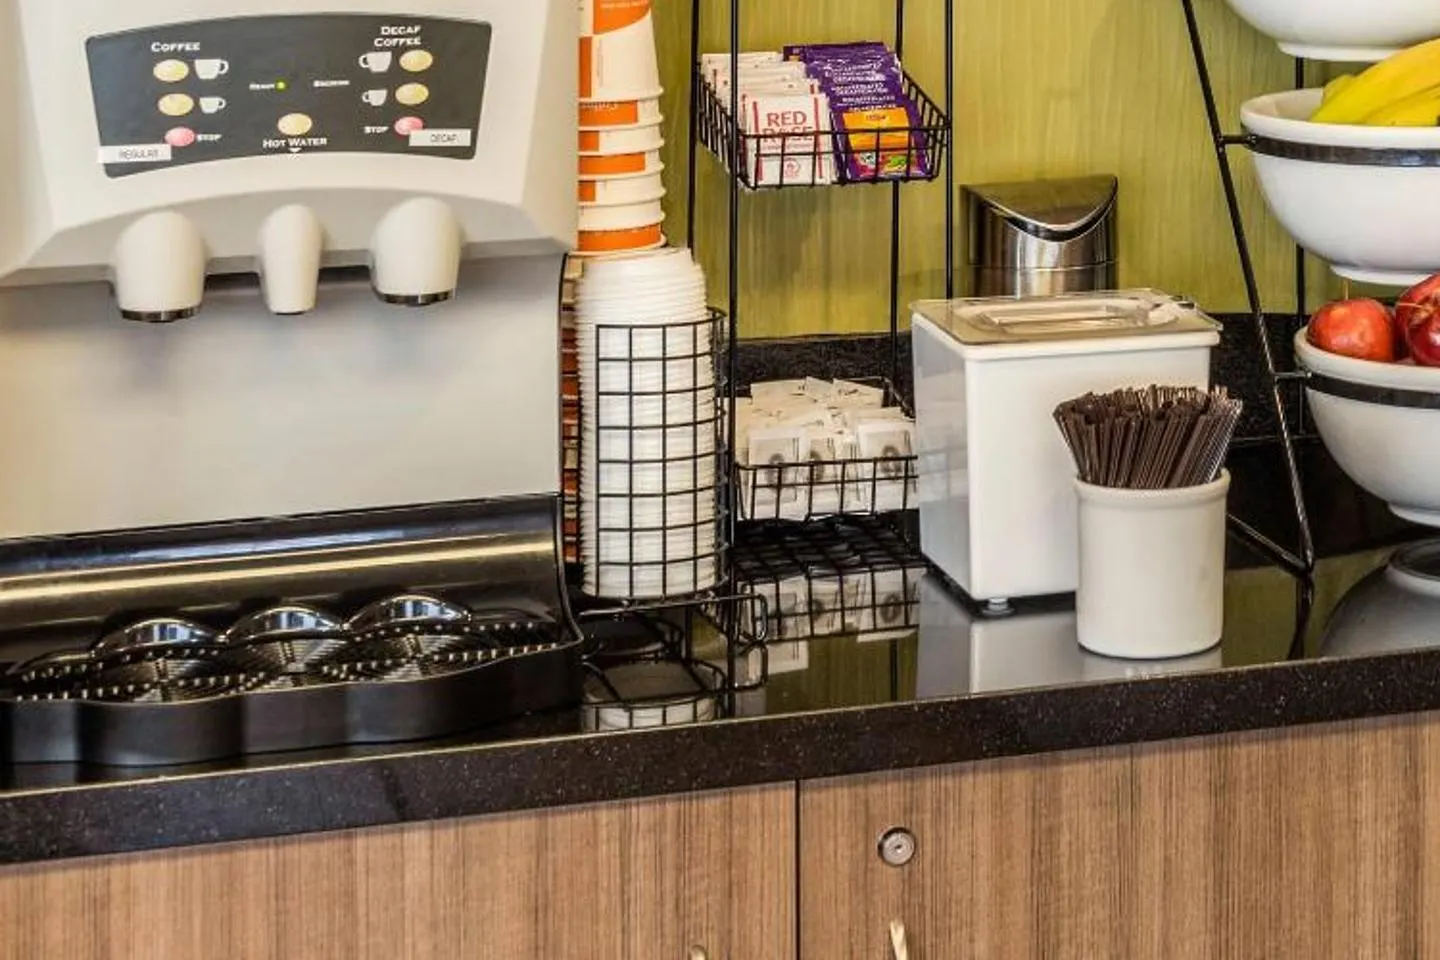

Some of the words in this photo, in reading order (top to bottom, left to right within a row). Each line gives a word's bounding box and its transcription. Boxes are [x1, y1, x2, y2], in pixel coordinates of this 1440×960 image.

[380, 24, 422, 36] DECAF
[151, 41, 201, 53] COFFEE
[373, 36, 422, 48] COFFEE
[766, 110, 808, 127] RED
[262, 138, 286, 149] HOT
[287, 136, 328, 148] WATER
